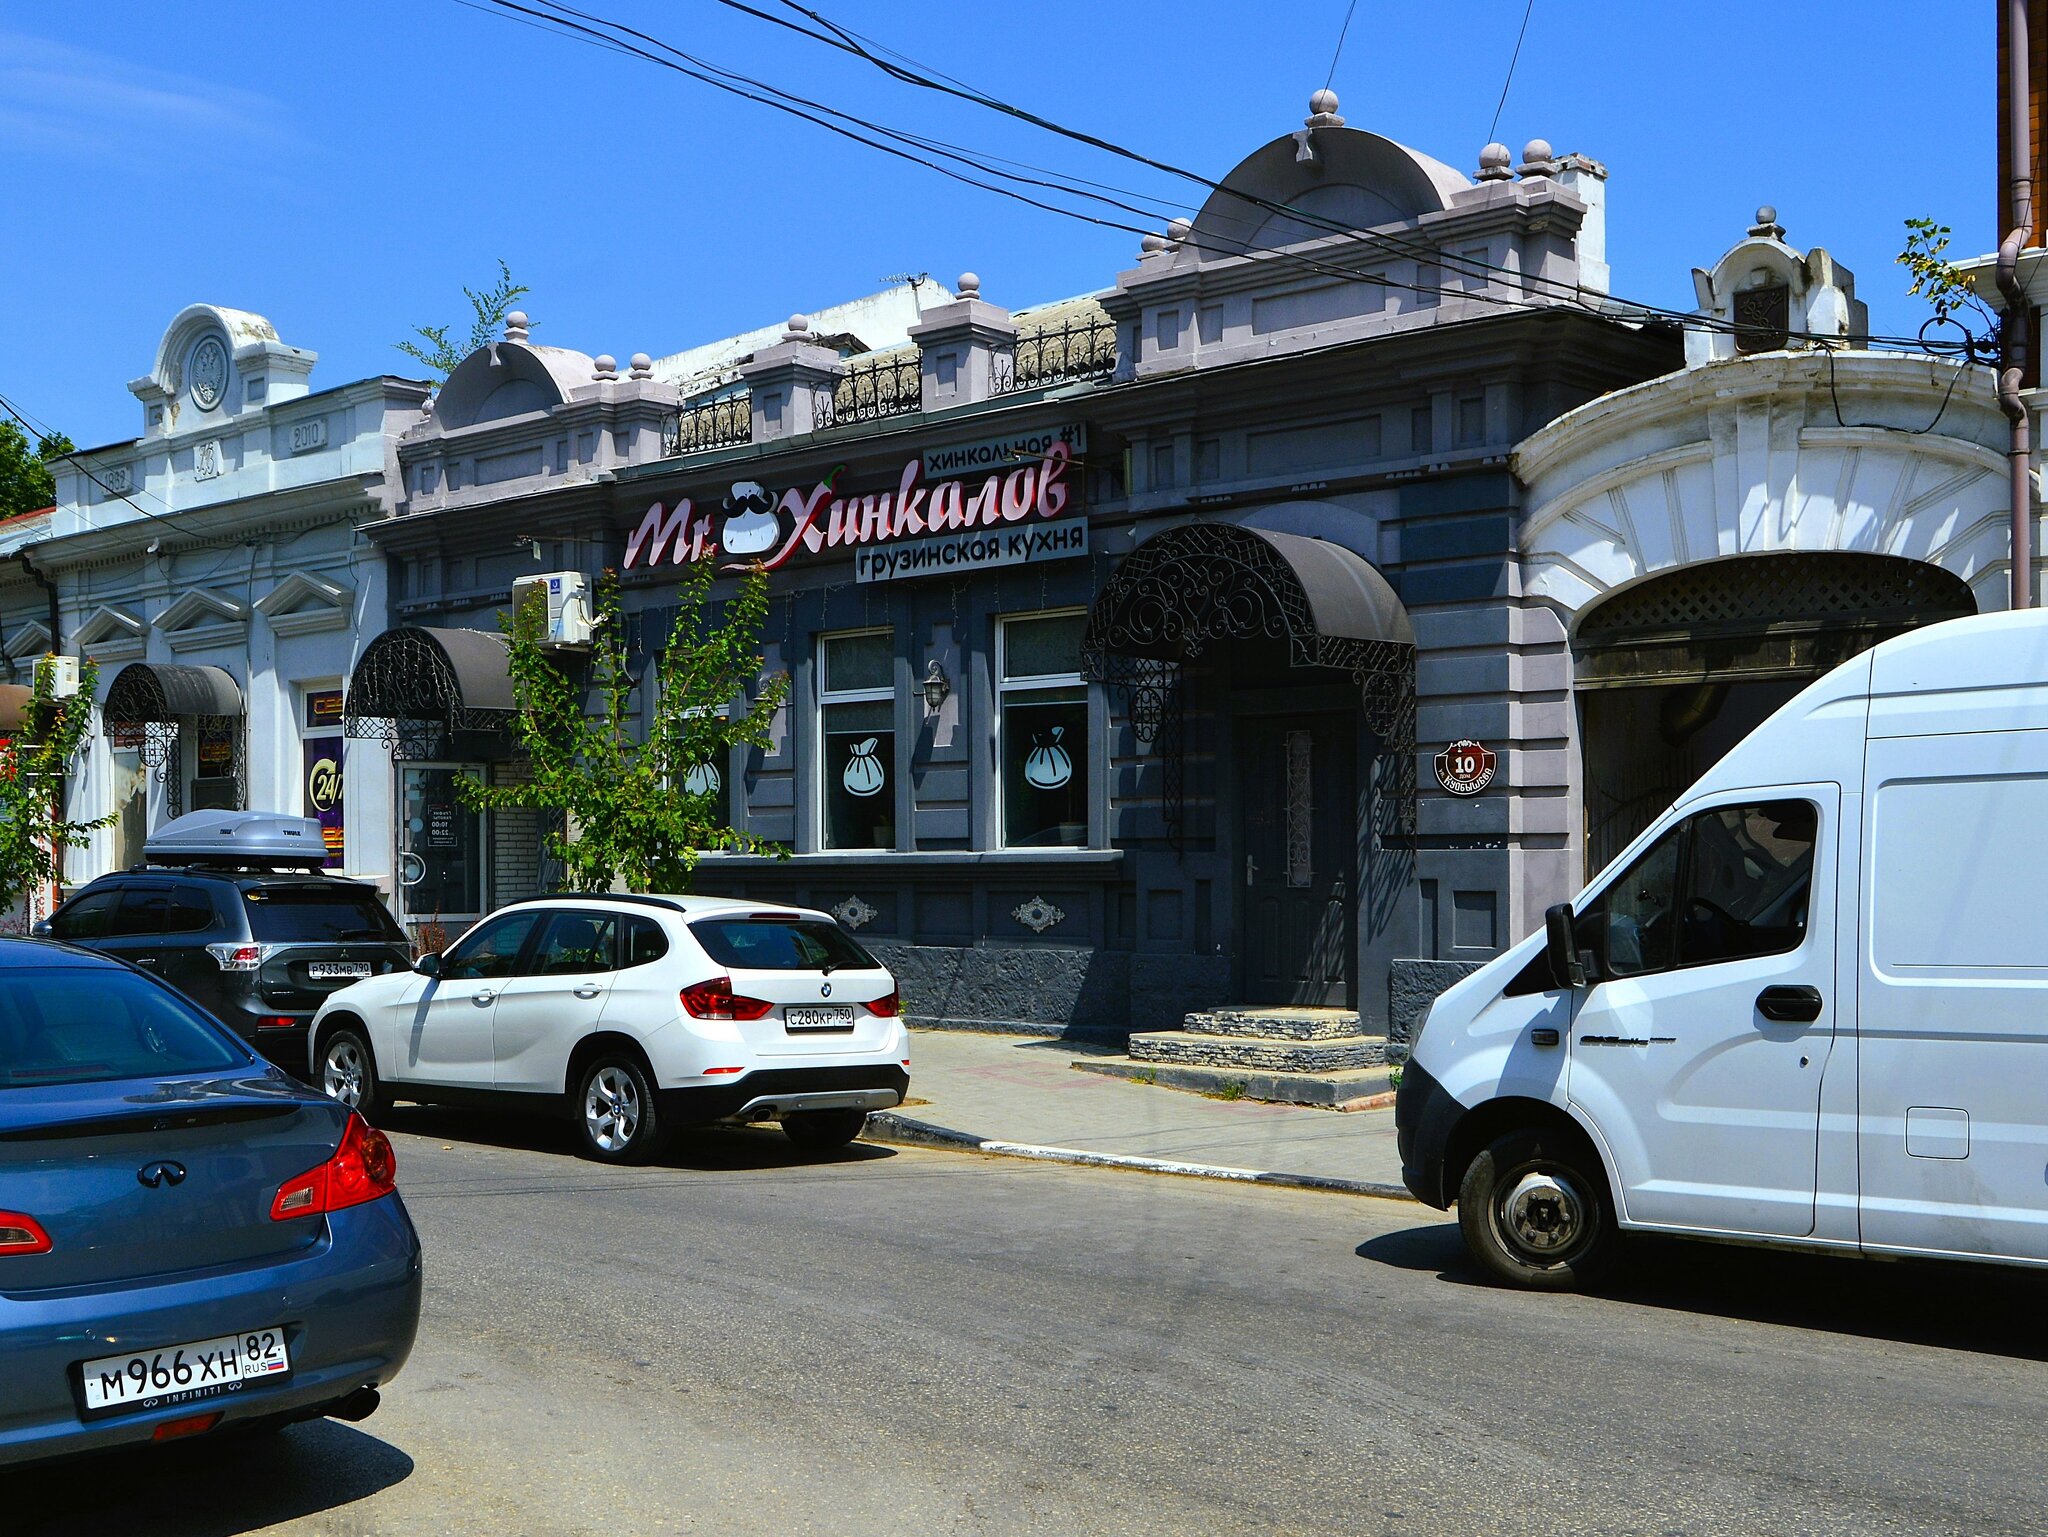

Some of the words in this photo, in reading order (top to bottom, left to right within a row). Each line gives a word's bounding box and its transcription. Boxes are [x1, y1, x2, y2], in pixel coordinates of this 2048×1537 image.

[293, 423, 319, 449] 2010
[860, 534, 1000, 580] грузинская
[1008, 526, 1083, 561] кухня
[1455, 756, 1475, 774] 10
[834, 1008, 850, 1020] 750
[246, 1332, 277, 1361] 82
[244, 1361, 268, 1375] RUS
[166, 1385, 221, 1404] INFINITI
